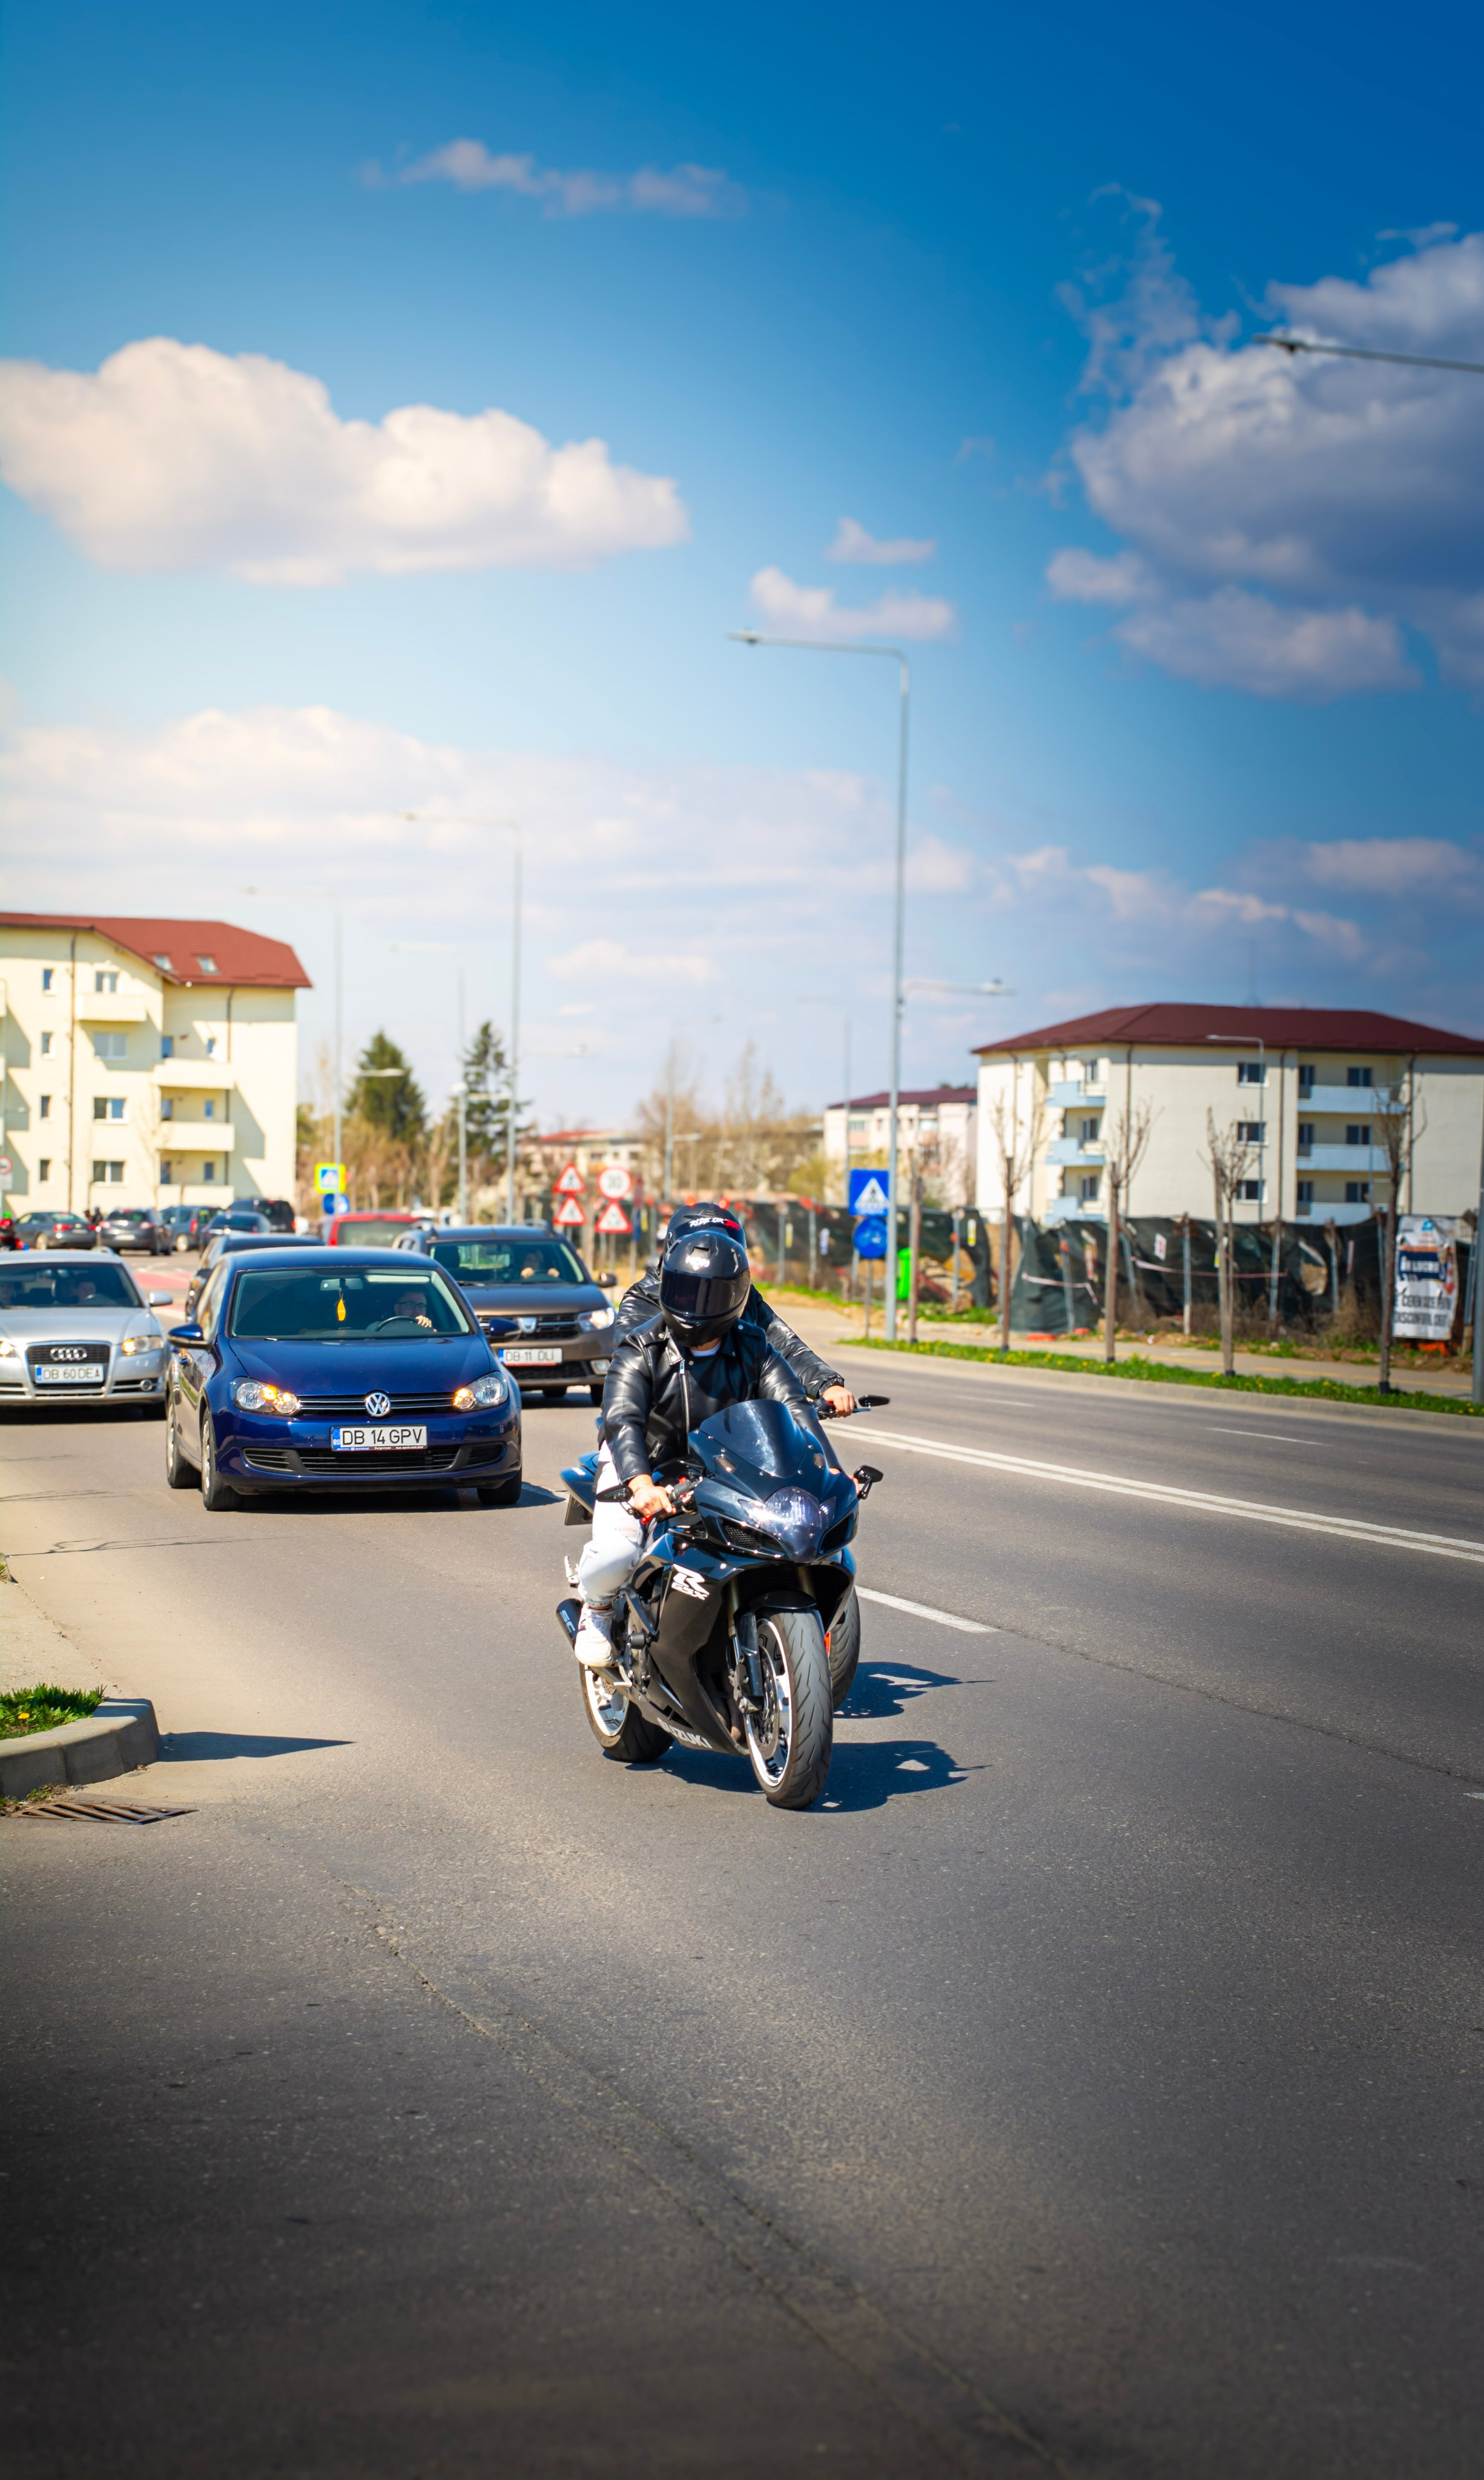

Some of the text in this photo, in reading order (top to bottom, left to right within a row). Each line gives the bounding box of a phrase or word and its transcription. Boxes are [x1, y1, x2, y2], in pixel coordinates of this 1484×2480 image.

[506, 1351, 520, 1361] DB
[525, 1351, 532, 1362] 11
[44, 1368, 100, 1379] DB 60 DEA
[343, 1429, 422, 1445] DB 14 GPV
[673, 1563, 710, 1595] R
[671, 1581, 708, 1600] GSX
[656, 1717, 713, 1749] SUZUKI
